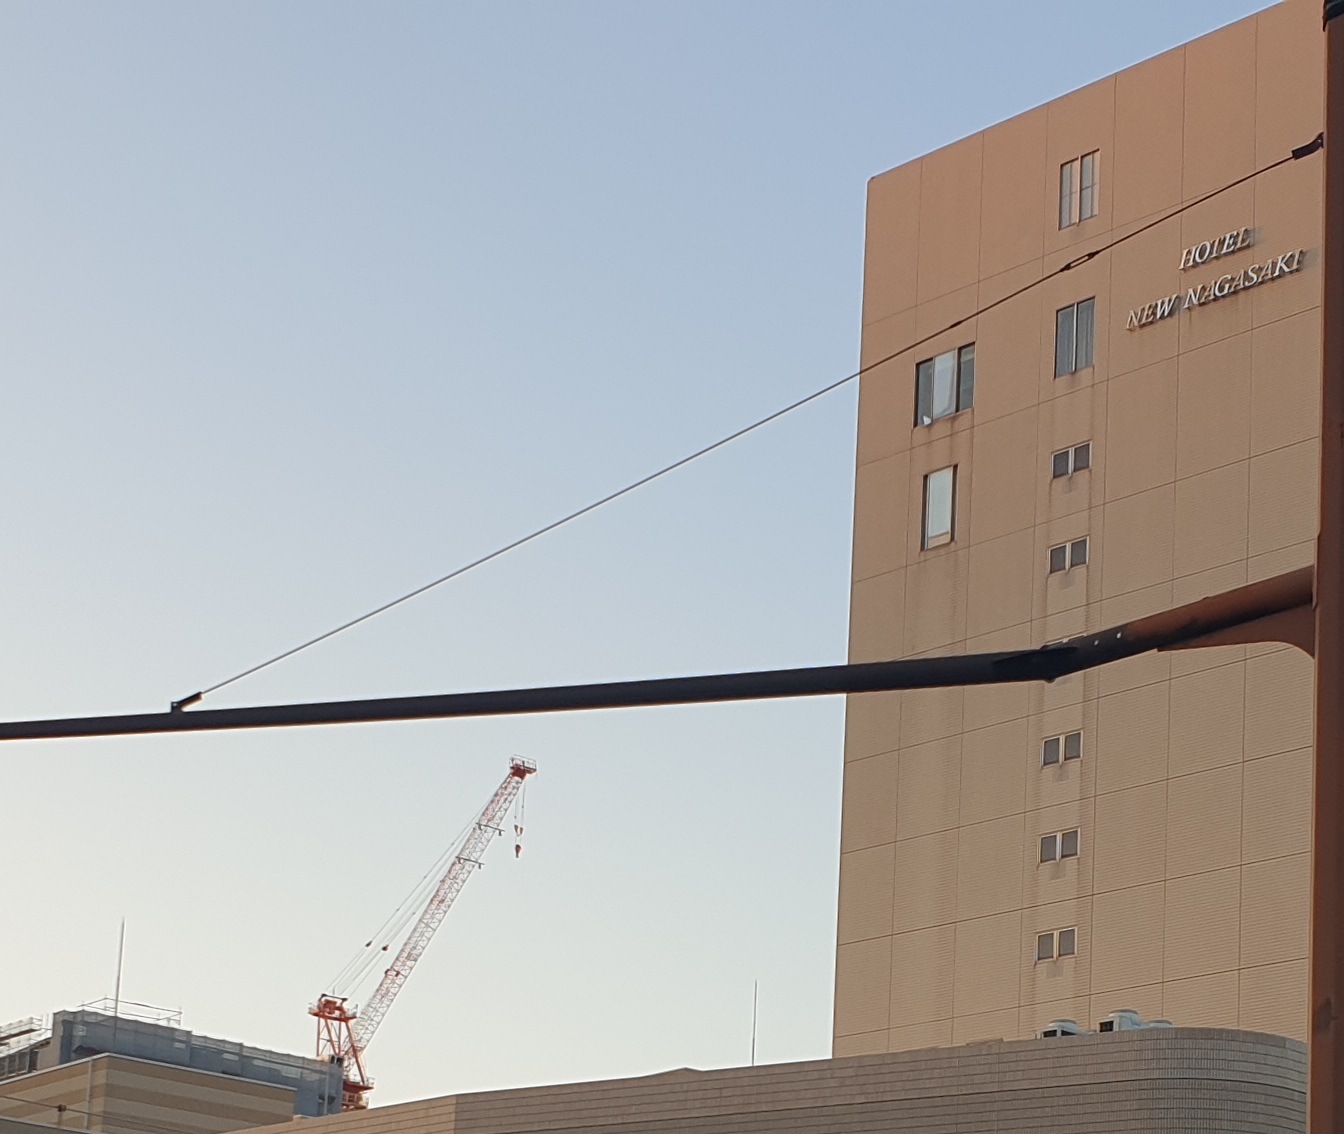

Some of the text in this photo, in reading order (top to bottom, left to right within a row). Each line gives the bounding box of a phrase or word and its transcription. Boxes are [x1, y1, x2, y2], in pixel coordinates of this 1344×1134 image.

[1178, 226, 1253, 271] HOTEL
[1126, 248, 1307, 331] NEW NAGASAKI
